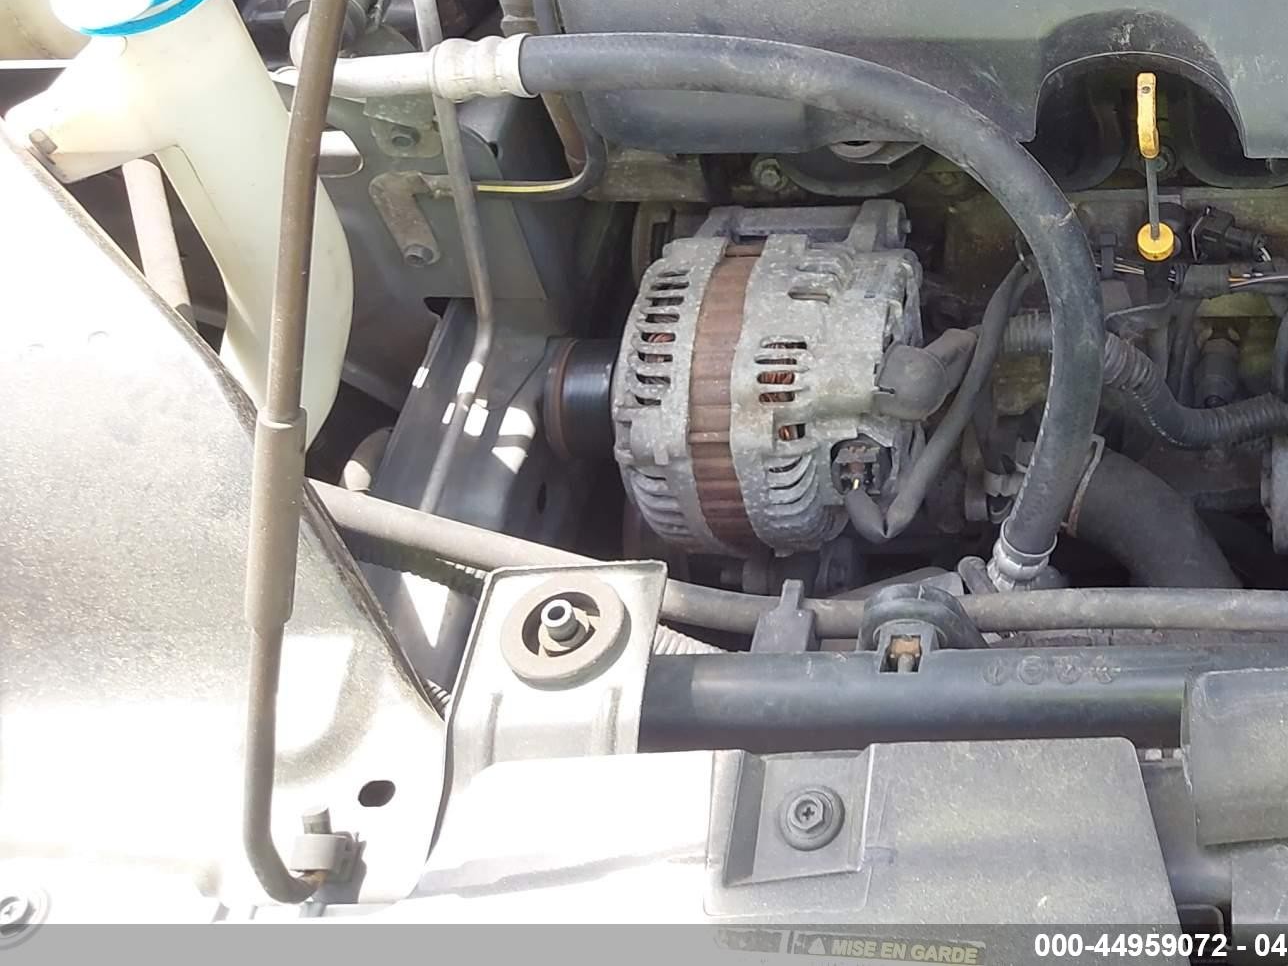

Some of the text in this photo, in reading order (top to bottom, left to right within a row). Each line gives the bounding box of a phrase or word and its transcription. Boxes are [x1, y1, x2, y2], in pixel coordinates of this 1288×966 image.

[831, 939, 978, 964] MISE EN GARDE
